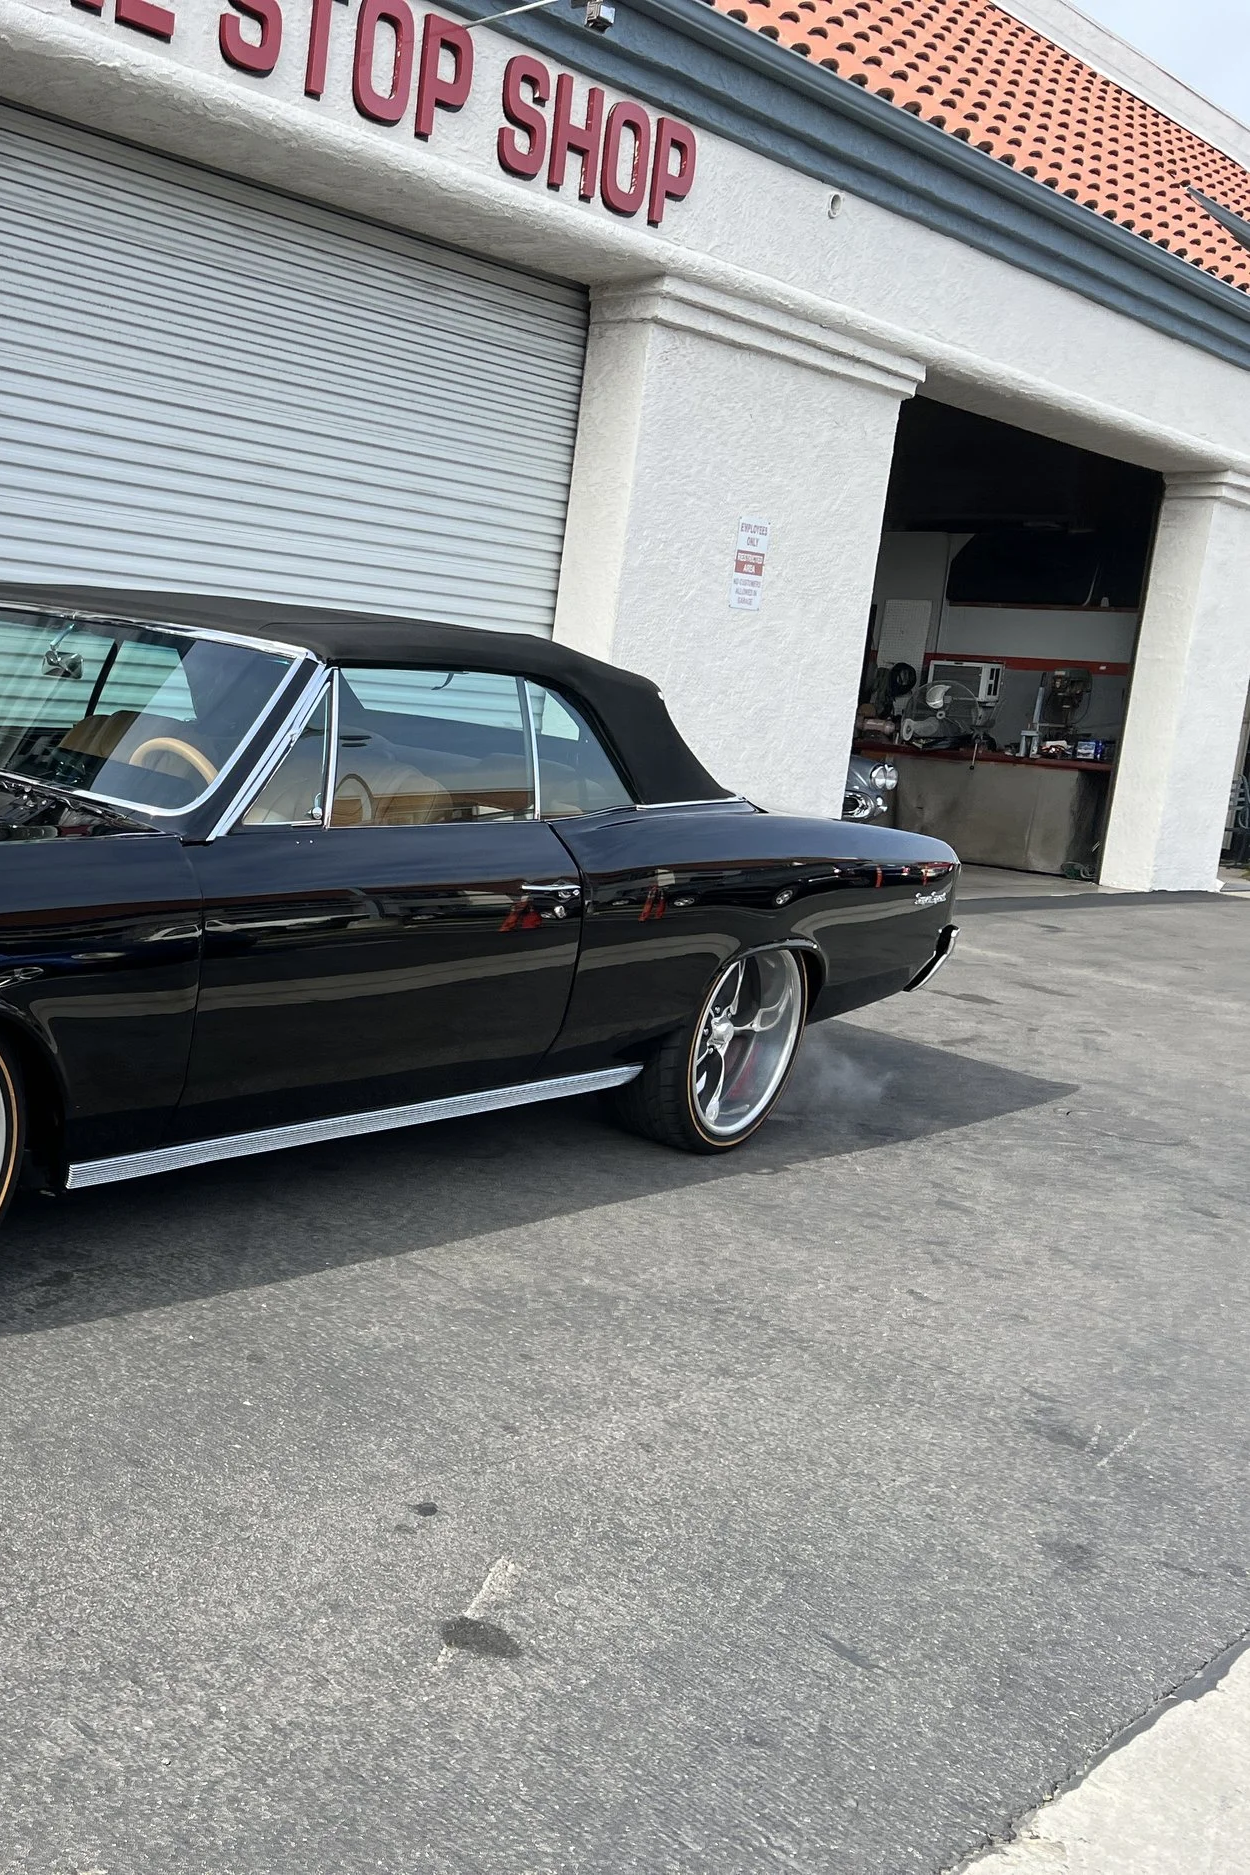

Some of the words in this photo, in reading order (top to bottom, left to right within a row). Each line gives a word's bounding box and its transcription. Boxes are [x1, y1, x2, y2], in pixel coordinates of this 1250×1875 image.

[219, 0, 474, 139] STOP
[497, 55, 697, 225] SHOP
[740, 522, 768, 536] EMPLOYEES
[747, 537, 759, 547] ONLY
